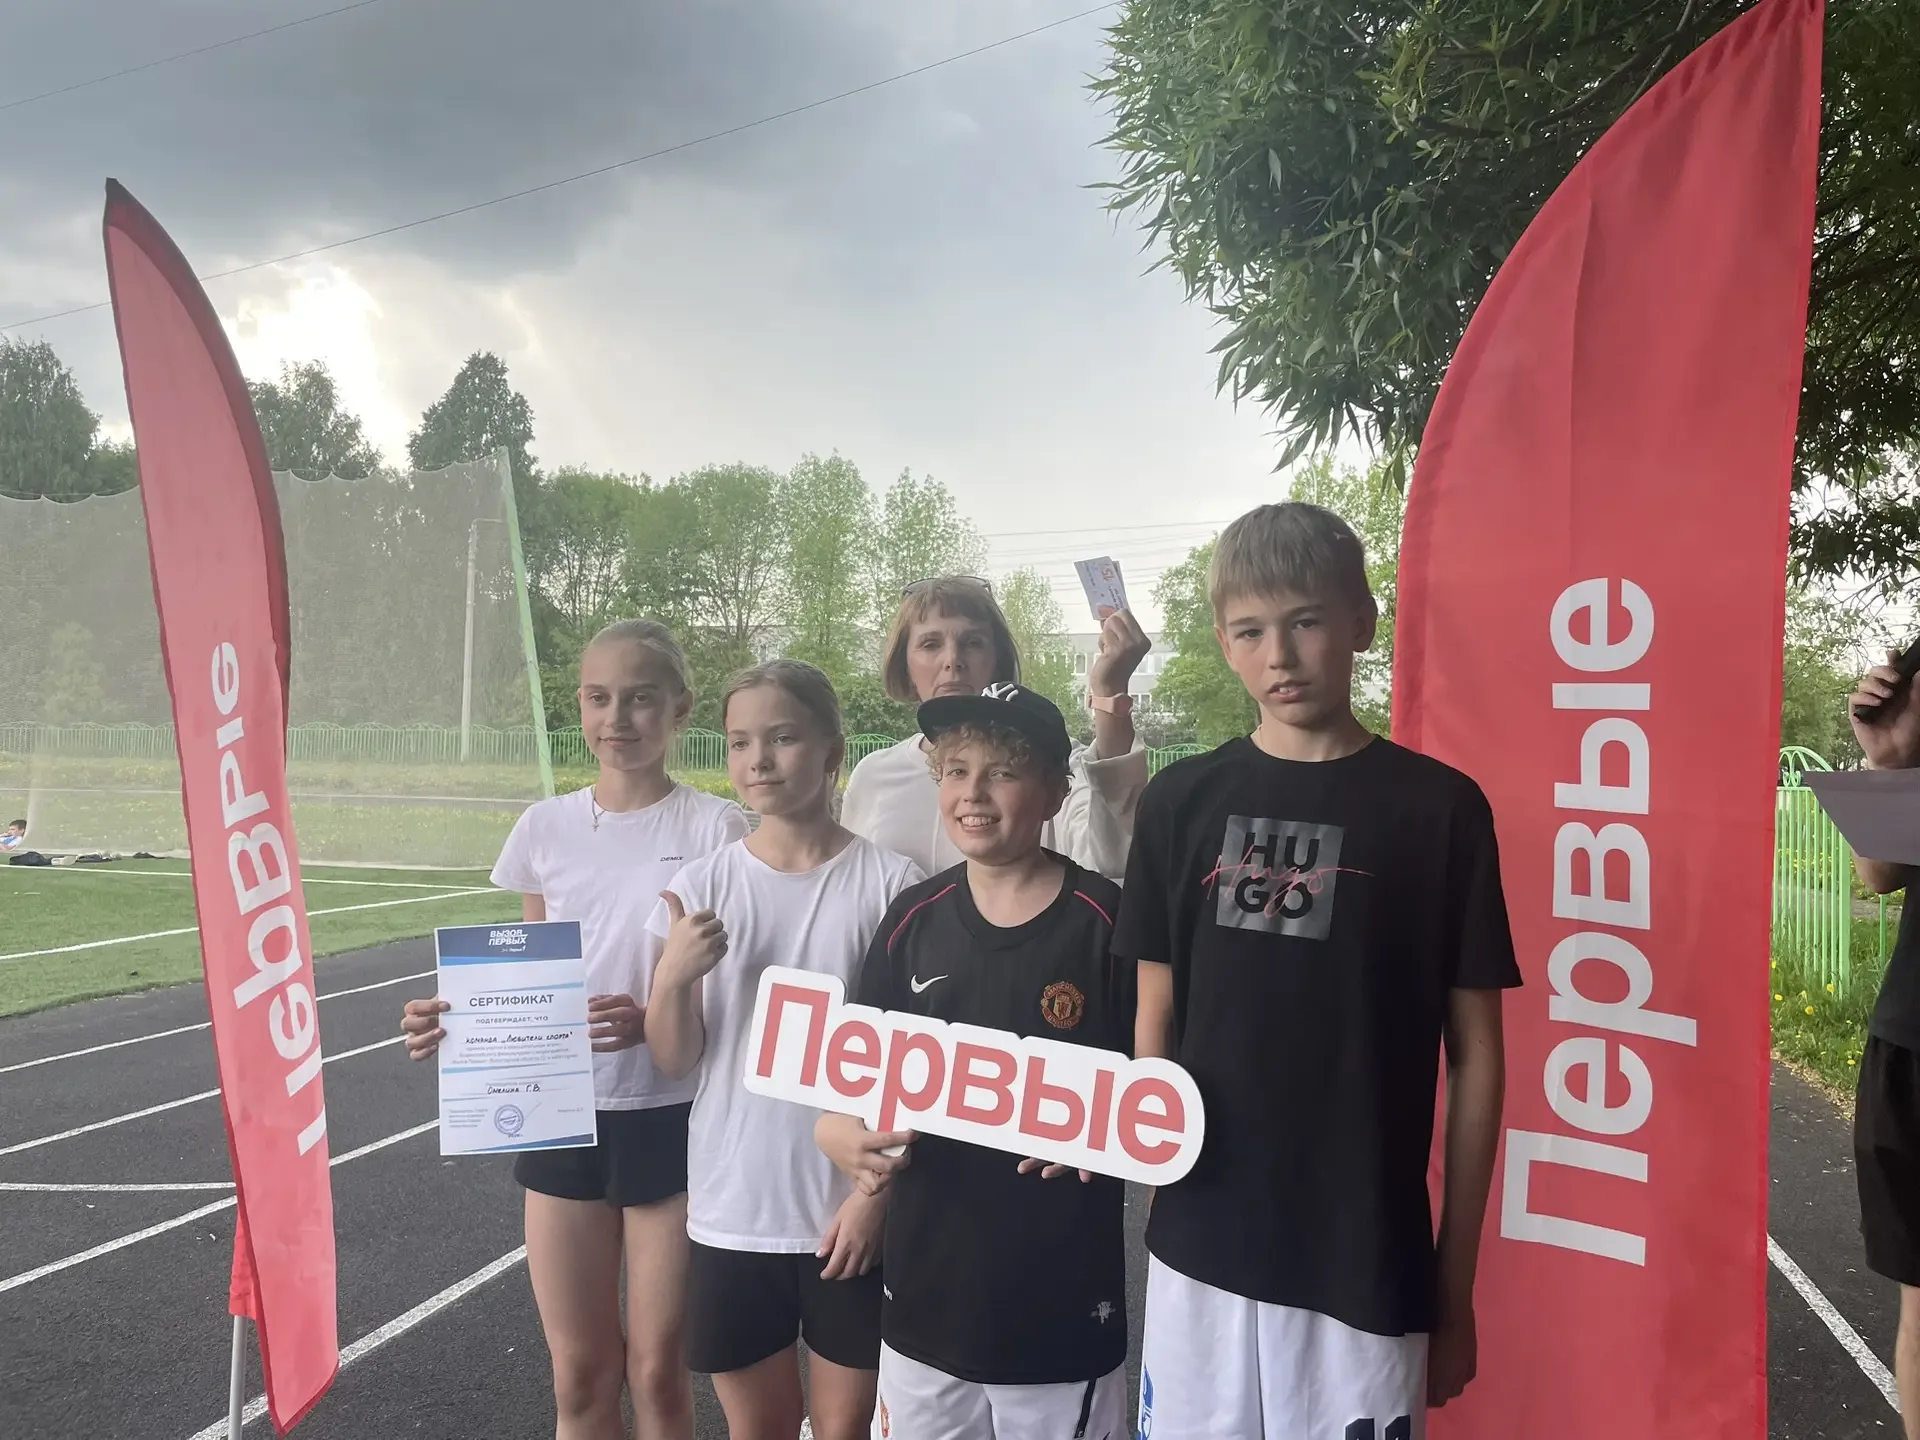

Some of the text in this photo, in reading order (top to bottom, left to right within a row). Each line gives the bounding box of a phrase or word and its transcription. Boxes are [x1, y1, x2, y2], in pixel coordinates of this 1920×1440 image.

[1501, 577, 1697, 1266] Первые
[488, 936, 527, 946] ПЕРВЫХ
[469, 994, 554, 1007] СЕРТИФИКАТ
[1047, 1014, 1073, 1026] UNITED
[755, 982, 1186, 1166] Первые
